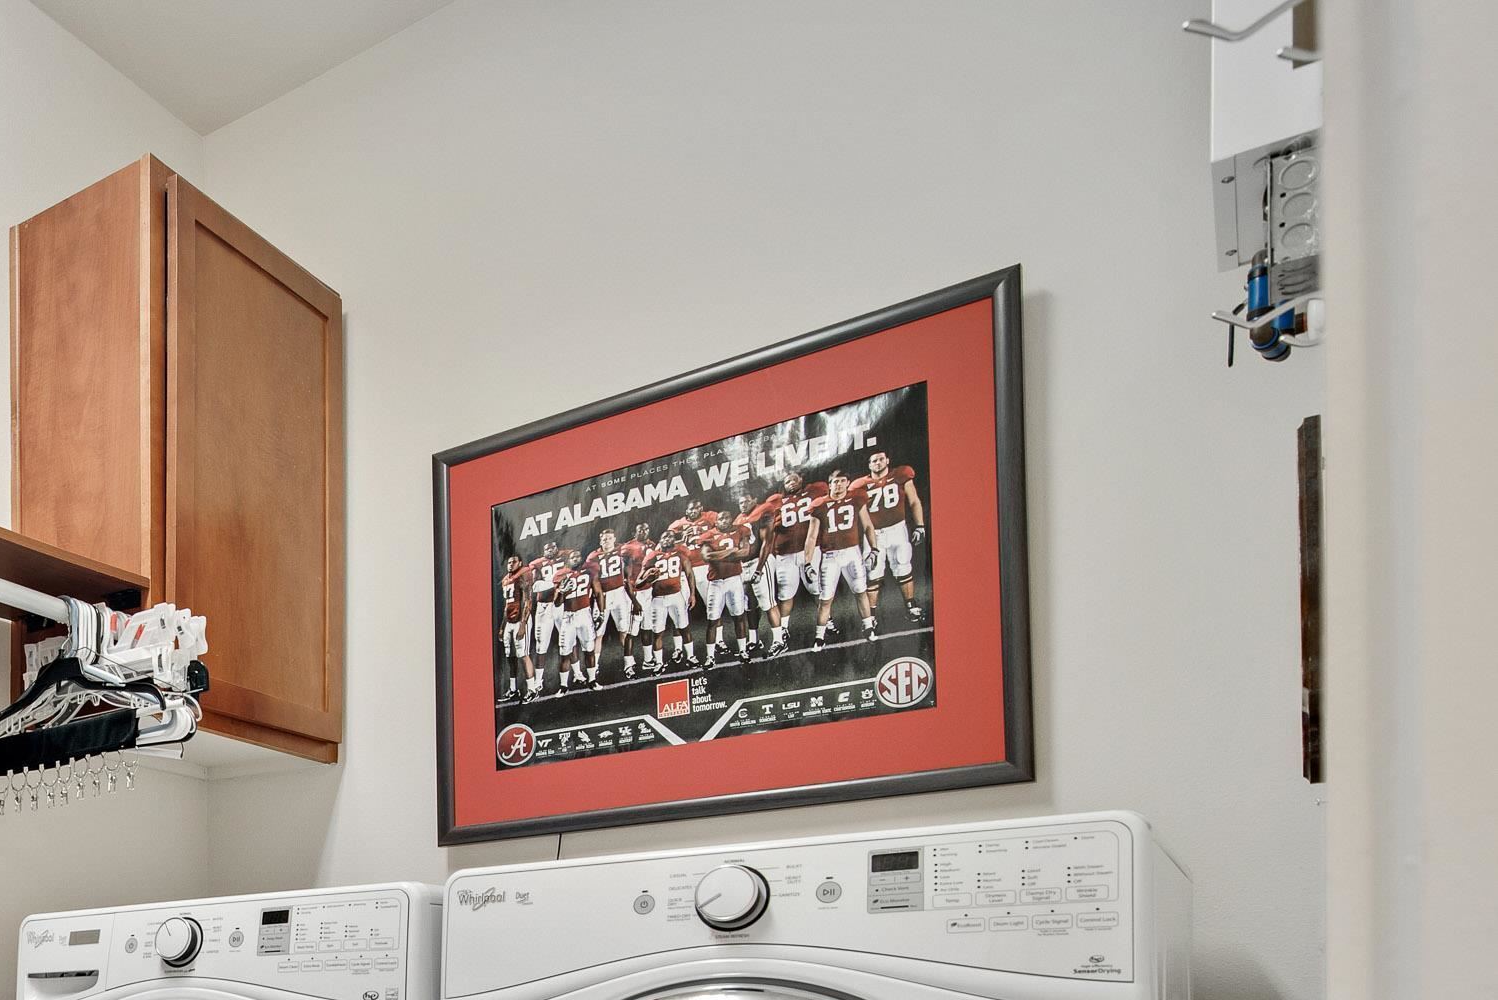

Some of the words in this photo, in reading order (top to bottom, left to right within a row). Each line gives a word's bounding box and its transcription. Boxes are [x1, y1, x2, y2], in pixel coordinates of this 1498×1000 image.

[519, 511, 553, 541] AT
[554, 474, 689, 531] ALABAMA
[697, 457, 749, 491] WE
[756, 434, 831, 476] LIVE
[585, 484, 598, 493] AT
[601, 476, 627, 488] SOME
[630, 464, 669, 480] PLACES
[868, 483, 899, 513] 78
[781, 497, 812, 528] 62
[826, 505, 855, 533] 13
[600, 554, 621, 578] 12
[654, 557, 680, 581] 28
[691, 677, 708, 687] Let's
[692, 686, 706, 695] talk
[881, 662, 927, 704] SEC
[663, 701, 688, 713] ALFA
[692, 694, 712, 704] about
[693, 701, 727, 712] tomorrow.
[782, 701, 801, 710] LSU
[537, 738, 553, 748] VT
[457, 888, 505, 909] Whirlpool
